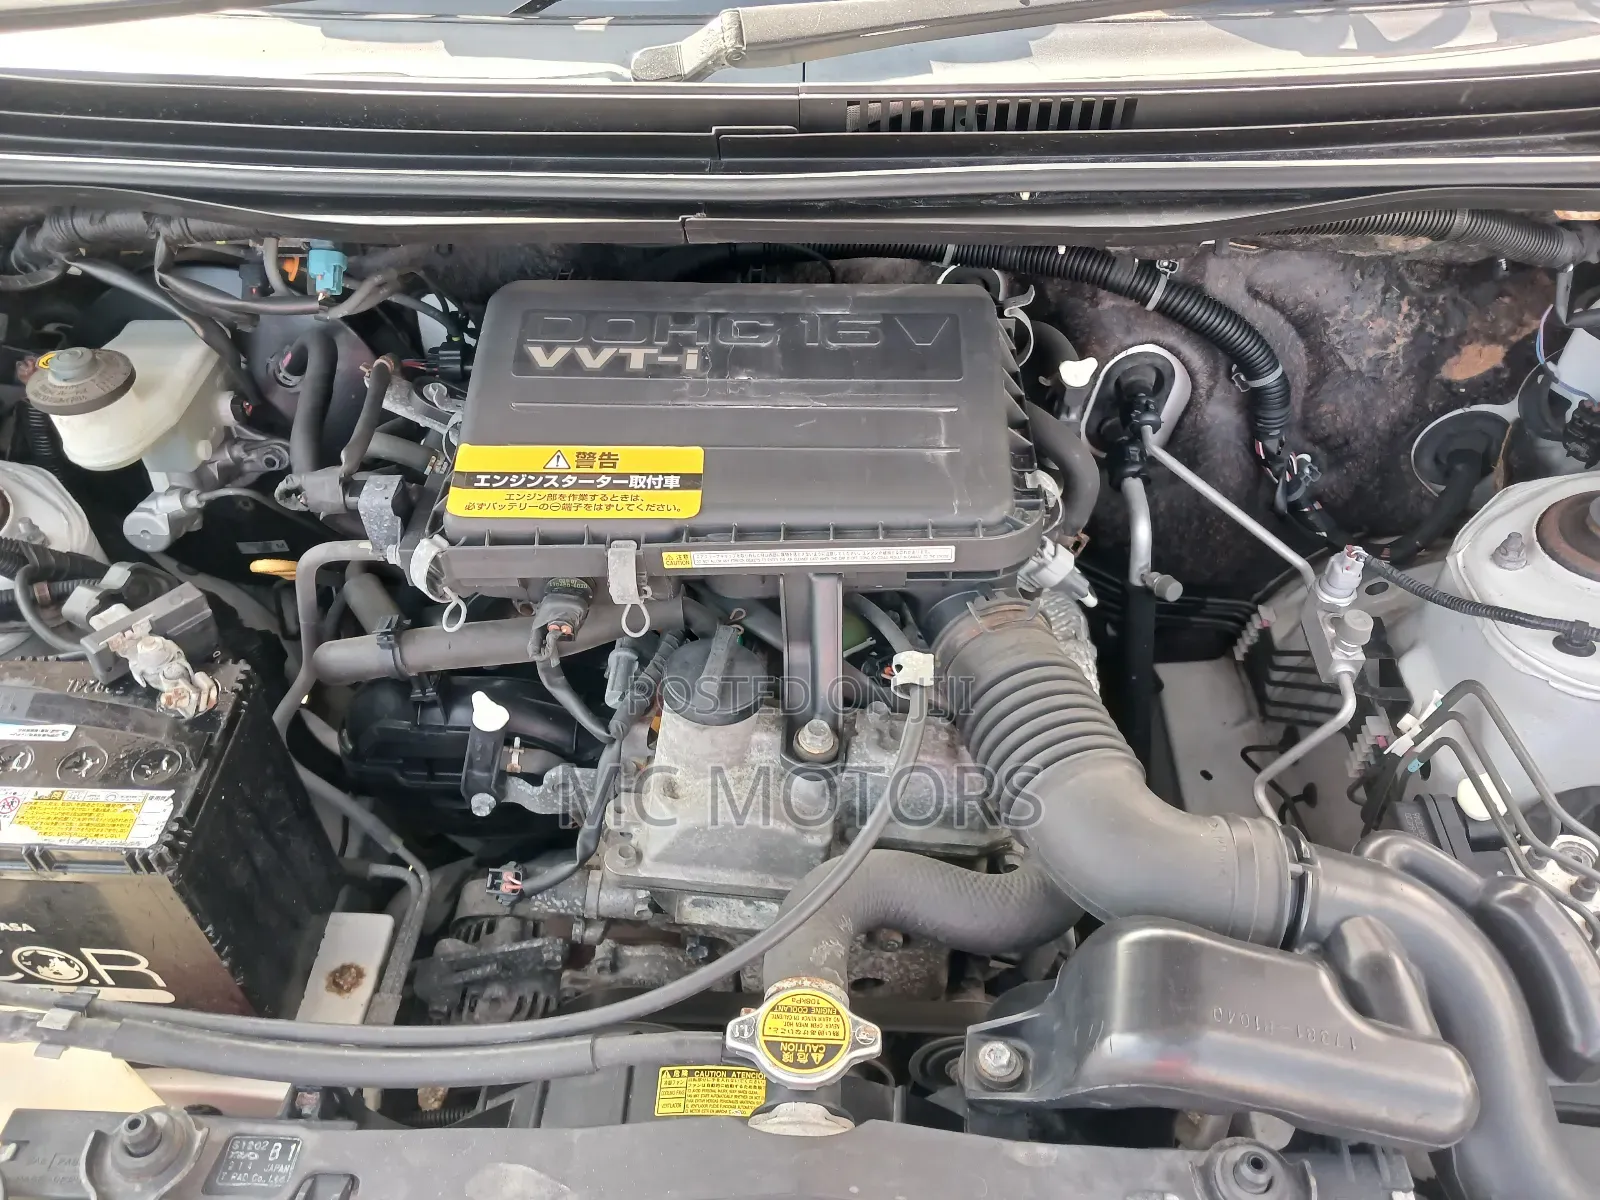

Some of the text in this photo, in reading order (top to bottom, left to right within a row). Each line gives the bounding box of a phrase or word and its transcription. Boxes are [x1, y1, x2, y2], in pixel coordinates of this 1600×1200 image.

[526, 313, 774, 346] DOHC
[526, 346, 700, 370] VVT-i
[574, 451, 620, 469] 警告
[473, 474, 681, 489] エンジンスターター取付車
[505, 493, 645, 502] エンジン部を作業するときは、
[774, 1005, 837, 1014] ENGINE COOLANT
[780, 1042, 826, 1052] CAUTION
[781, 1051, 809, 1064] 危険
[694, 1070, 727, 1078] CAUTION
[263, 1163, 291, 1173] JAPAN
